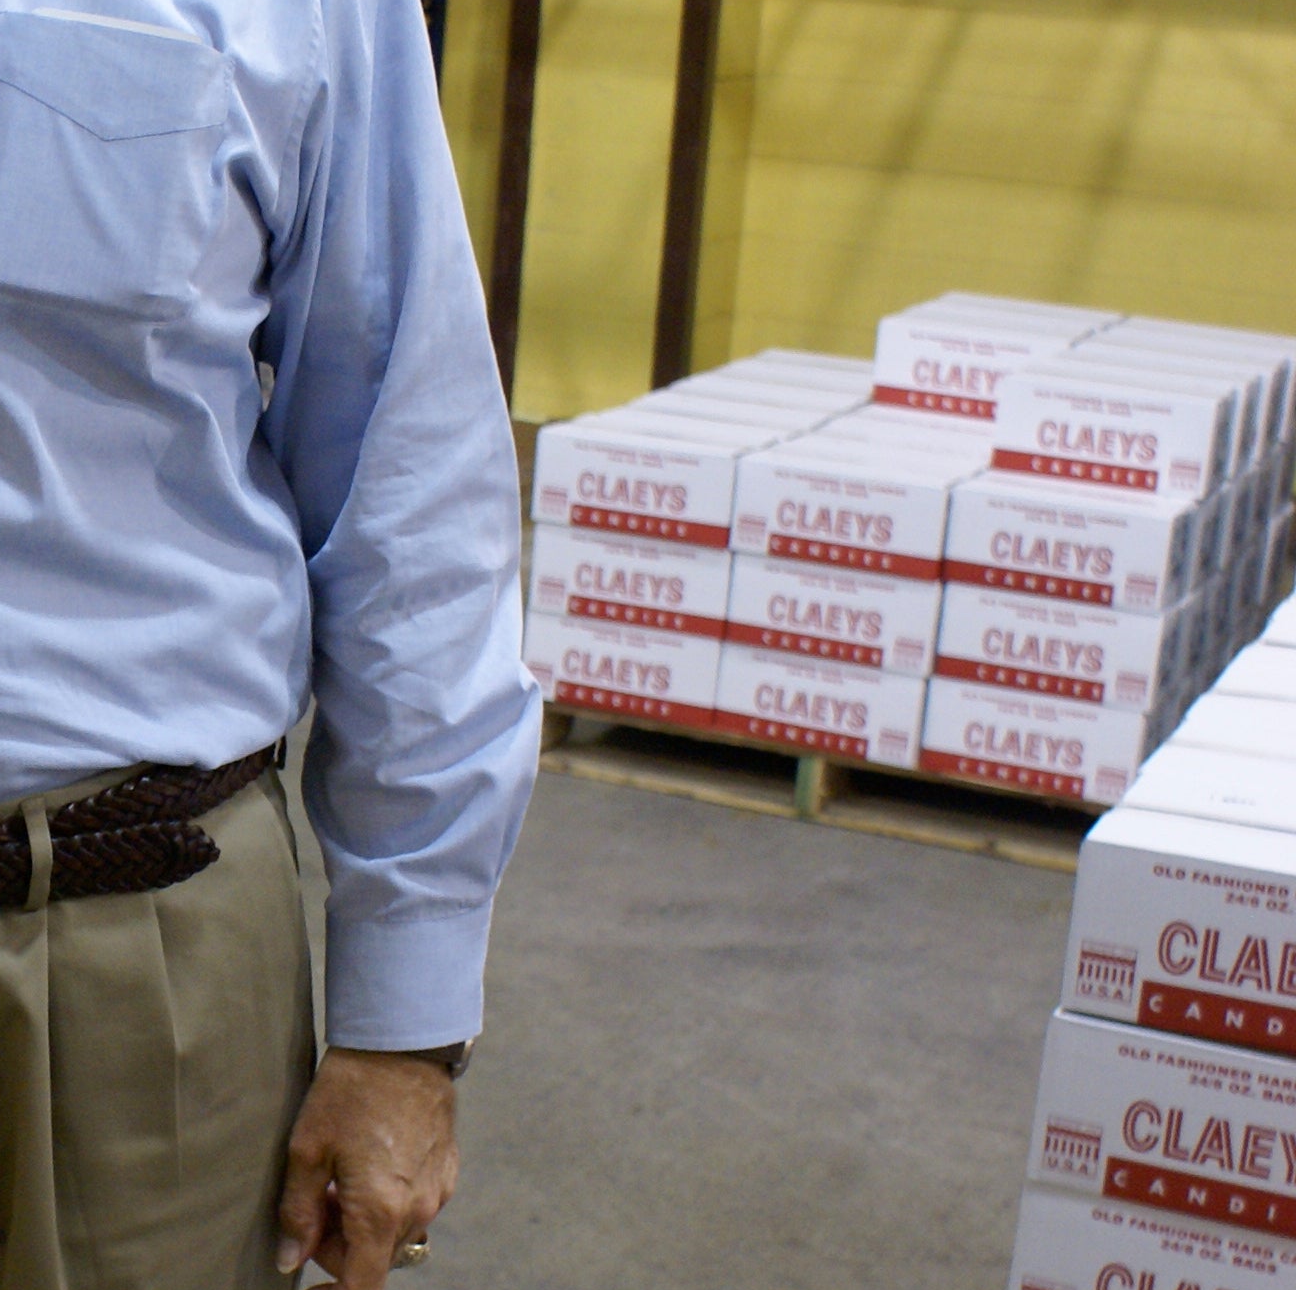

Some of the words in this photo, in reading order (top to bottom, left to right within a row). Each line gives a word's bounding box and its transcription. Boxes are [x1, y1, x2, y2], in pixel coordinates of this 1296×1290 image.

[912, 359, 1003, 395] CLAEY
[1036, 419, 1158, 464] CLAEYS
[576, 470, 688, 513] CLAEYS
[776, 499, 893, 545] CLAEYS
[990, 531, 1114, 577] CLAEYS
[573, 562, 684, 603] CLAEYS
[767, 594, 883, 640] CLAEYS
[561, 647, 671, 691] CLAEYS
[982, 627, 1105, 674] CLAEYS
[755, 684, 867, 730] CLAEYS
[964, 721, 1084, 770] CLAEYS
[1152, 864, 1186, 881] OLD
[1191, 870, 1290, 898] FASHIONED
[1149, 995, 1285, 1036] CAND
[1118, 1044, 1152, 1060] OLD
[1156, 1052, 1253, 1081] FASHIONED
[1257, 1073, 1296, 1092] HAR
[1091, 1207, 1124, 1225] OLD
[1129, 1217, 1222, 1247] FASHIONED
[1228, 1239, 1274, 1260] HARD
